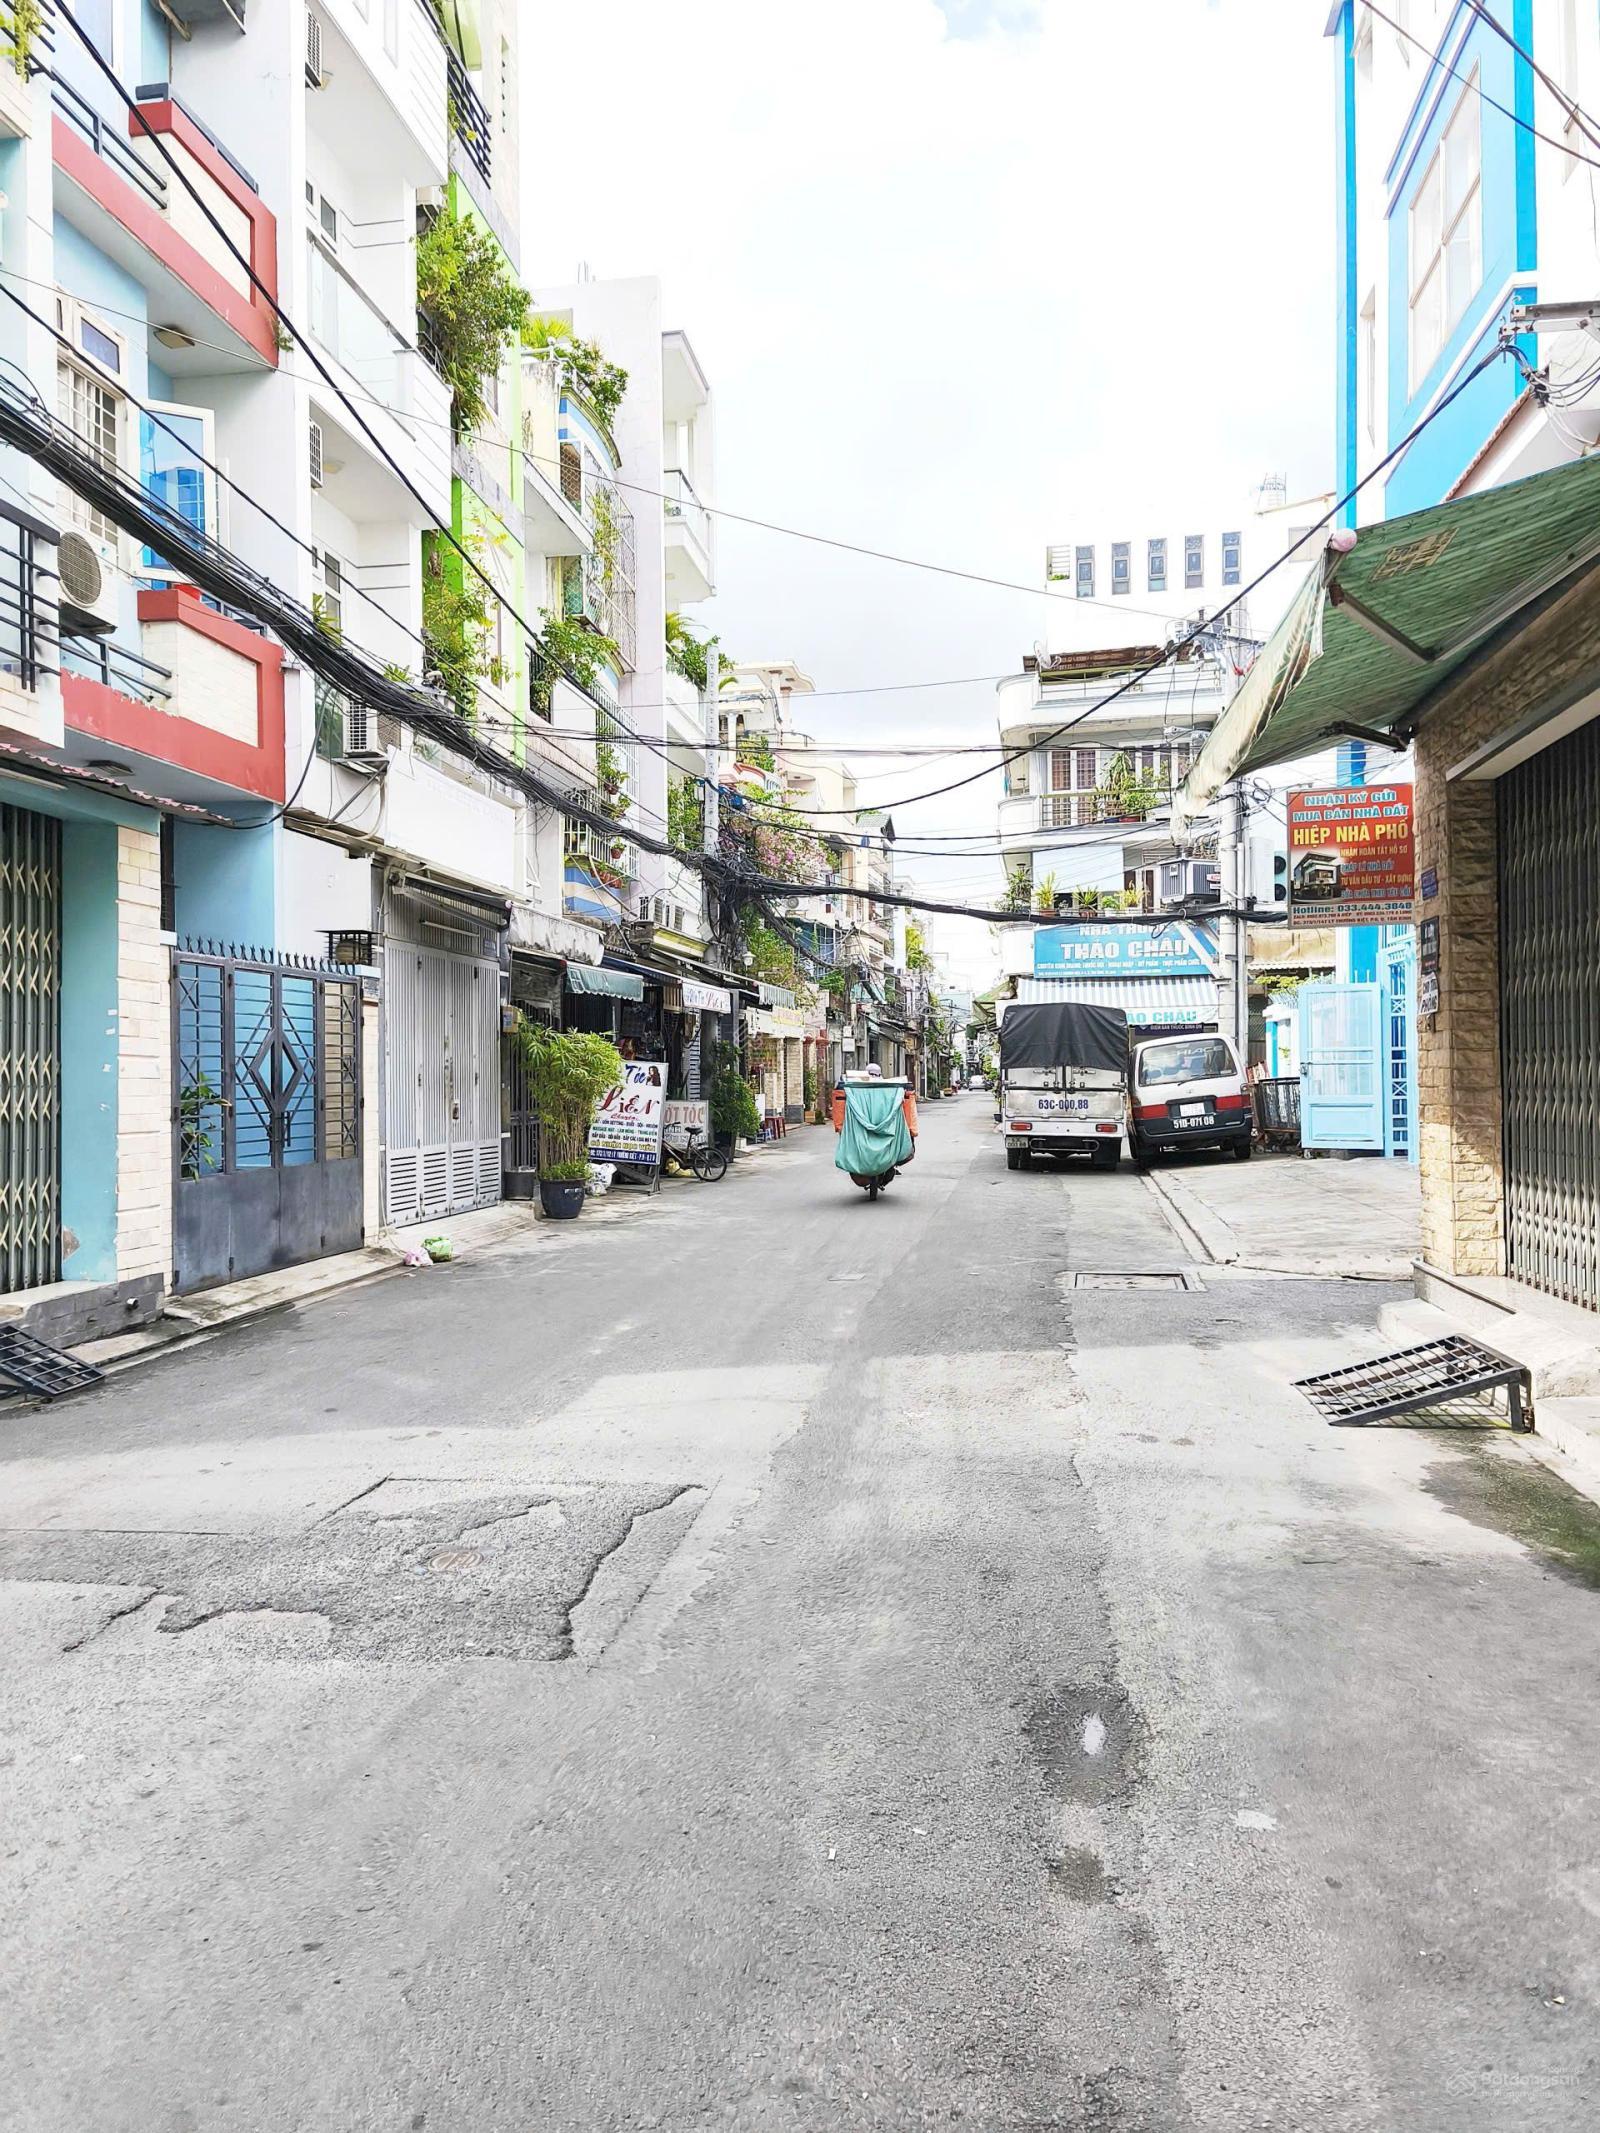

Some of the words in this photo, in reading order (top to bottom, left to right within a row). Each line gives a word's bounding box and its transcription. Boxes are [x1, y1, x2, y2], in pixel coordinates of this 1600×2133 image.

[1305, 793, 1345, 807] NHẬN
[1348, 792, 1367, 804] KÝ
[1372, 789, 1396, 802] GỬI
[1293, 811, 1322, 822] MUA
[1324, 808, 1351, 820] BÁN
[1354, 806, 1381, 818] NHÀ
[1384, 803, 1408, 816] ĐẤT
[1294, 824, 1330, 848] HIỆP
[1336, 822, 1370, 843] NHÀ
[1376, 817, 1408, 840] PHỐ
[1060, 938, 1120, 960] THẢO
[1128, 937, 1190, 958] CHÂU
[1127, 1010, 1147, 1023] ẢO
[1152, 1009, 1197, 1022] CHÂU
[664, 1104, 679, 1124] ỚT
[1038, 1099, 1089, 1110] 63C-000.88
